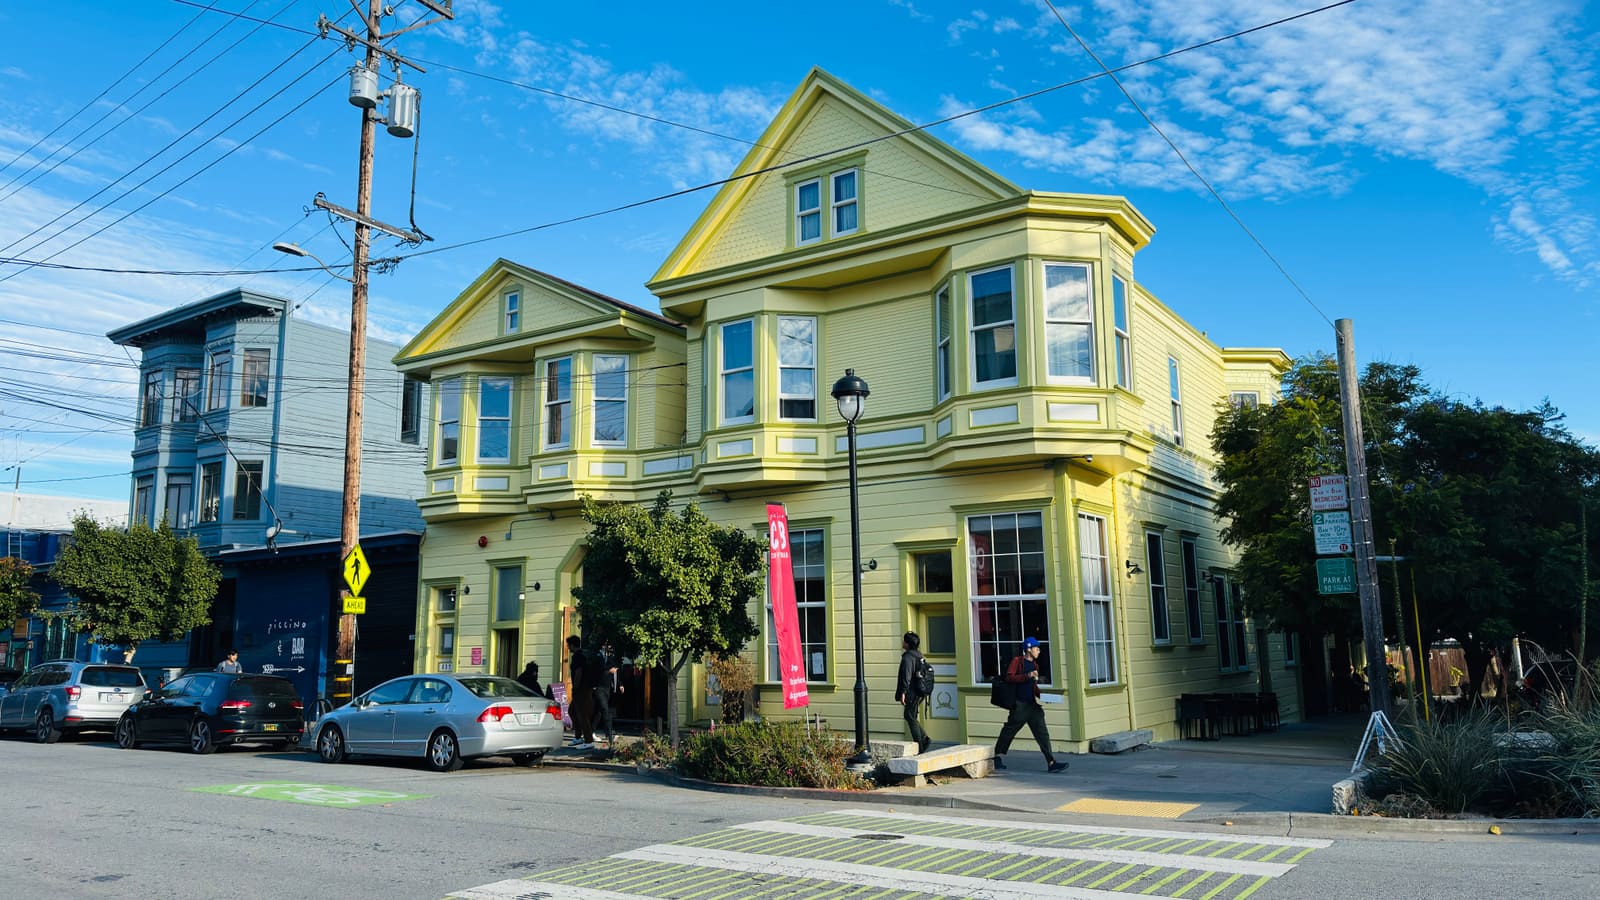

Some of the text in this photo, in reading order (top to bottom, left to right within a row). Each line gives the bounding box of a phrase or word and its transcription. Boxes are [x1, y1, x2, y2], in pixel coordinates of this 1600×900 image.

[1310, 477, 1343, 487] NO PARKING
[1314, 495, 1344, 503] WEDNESDAY
[1315, 514, 1323, 524] 2
[1322, 575, 1351, 585] PARK AT
[1323, 584, 1332, 593] 90
[346, 601, 363, 610] AHEAD
[291, 637, 305, 655] BAR
